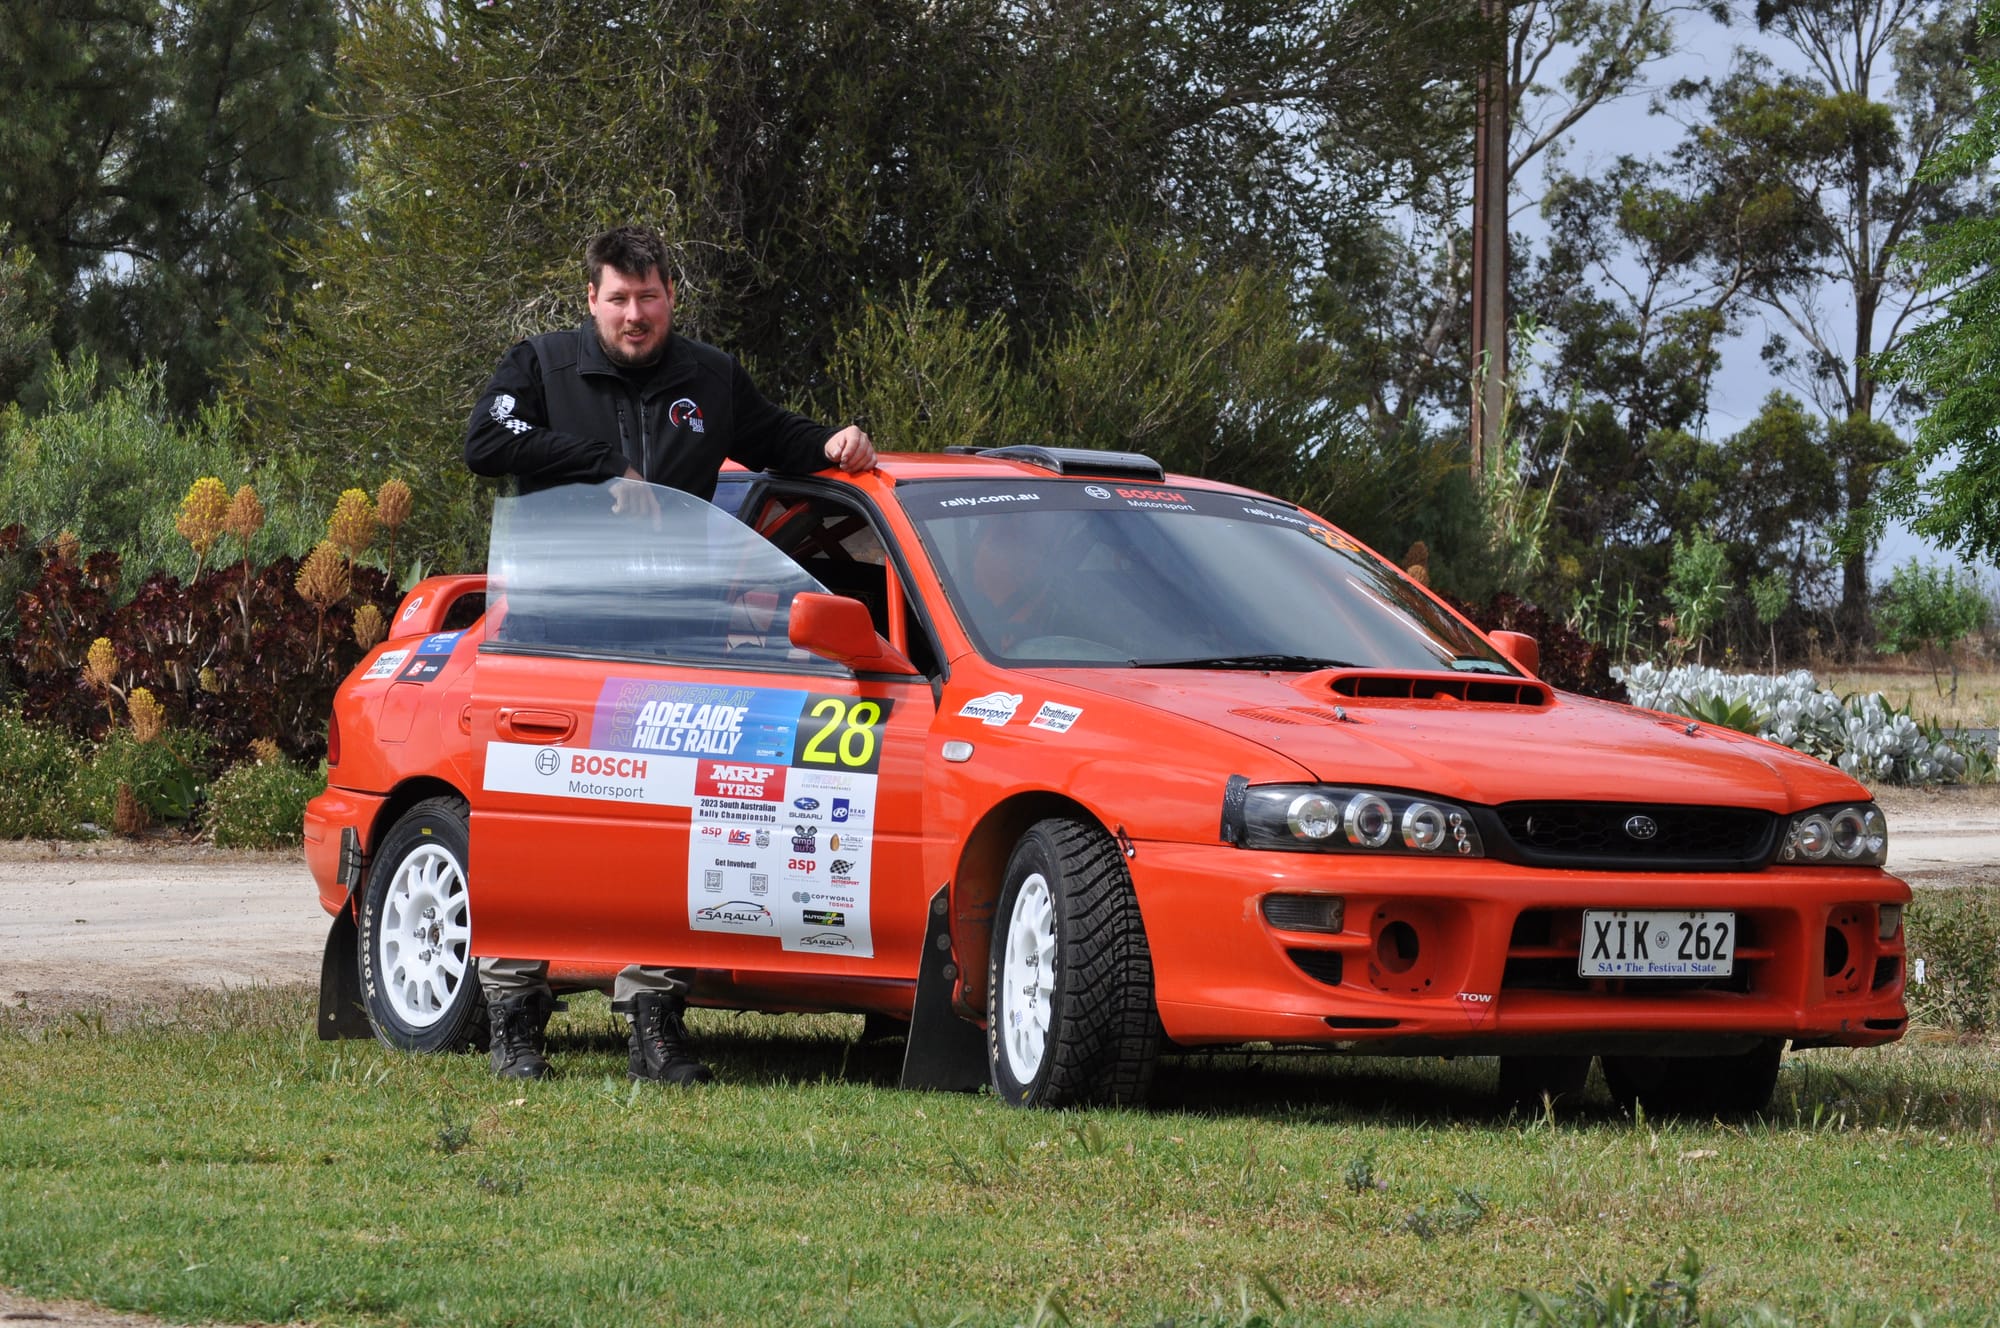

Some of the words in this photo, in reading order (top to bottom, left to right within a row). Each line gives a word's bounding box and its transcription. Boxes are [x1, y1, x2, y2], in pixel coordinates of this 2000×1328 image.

[939, 493, 1040, 507] rally.com.au
[1115, 488, 1186, 503] BOSCH
[1127, 499, 1196, 512] Motorsport
[642, 684, 755, 707] POWERPLAY
[610, 682, 645, 748] 2023
[636, 700, 748, 733] ADELAIDE
[961, 706, 1012, 720] motorsport
[1040, 705, 1079, 722] Strathfield
[802, 698, 881, 767] 28
[632, 726, 683, 752] HILLS
[682, 730, 743, 755] RALLY
[571, 755, 648, 779] BOSCH
[710, 764, 774, 784] MRF
[568, 780, 645, 799] Motorsport
[716, 782, 764, 797] TYRES
[701, 799, 719, 809] 2023
[720, 799, 739, 810] South
[740, 801, 777, 813] Australian
[699, 809, 719, 819] Rally
[721, 810, 776, 823] Championship
[788, 811, 823, 820] SUBARU
[701, 826, 722, 838] asp
[728, 829, 752, 844] MSS
[715, 858, 726, 866] Get
[727, 859, 757, 869] Involved!
[788, 858, 816, 874] asp
[811, 894, 855, 902] COPYWORLD
[828, 901, 854, 909] TOSHIBA
[705, 910, 722, 920] SA
[724, 912, 761, 922] RALLY
[1591, 920, 1650, 960] XIK
[1677, 921, 1730, 960] 262
[1598, 963, 1613, 972] SA
[1625, 963, 1644, 972] The
[1648, 963, 1686, 972] Festival
[1691, 963, 1717, 972] State
[1460, 993, 1493, 1002] TOW
